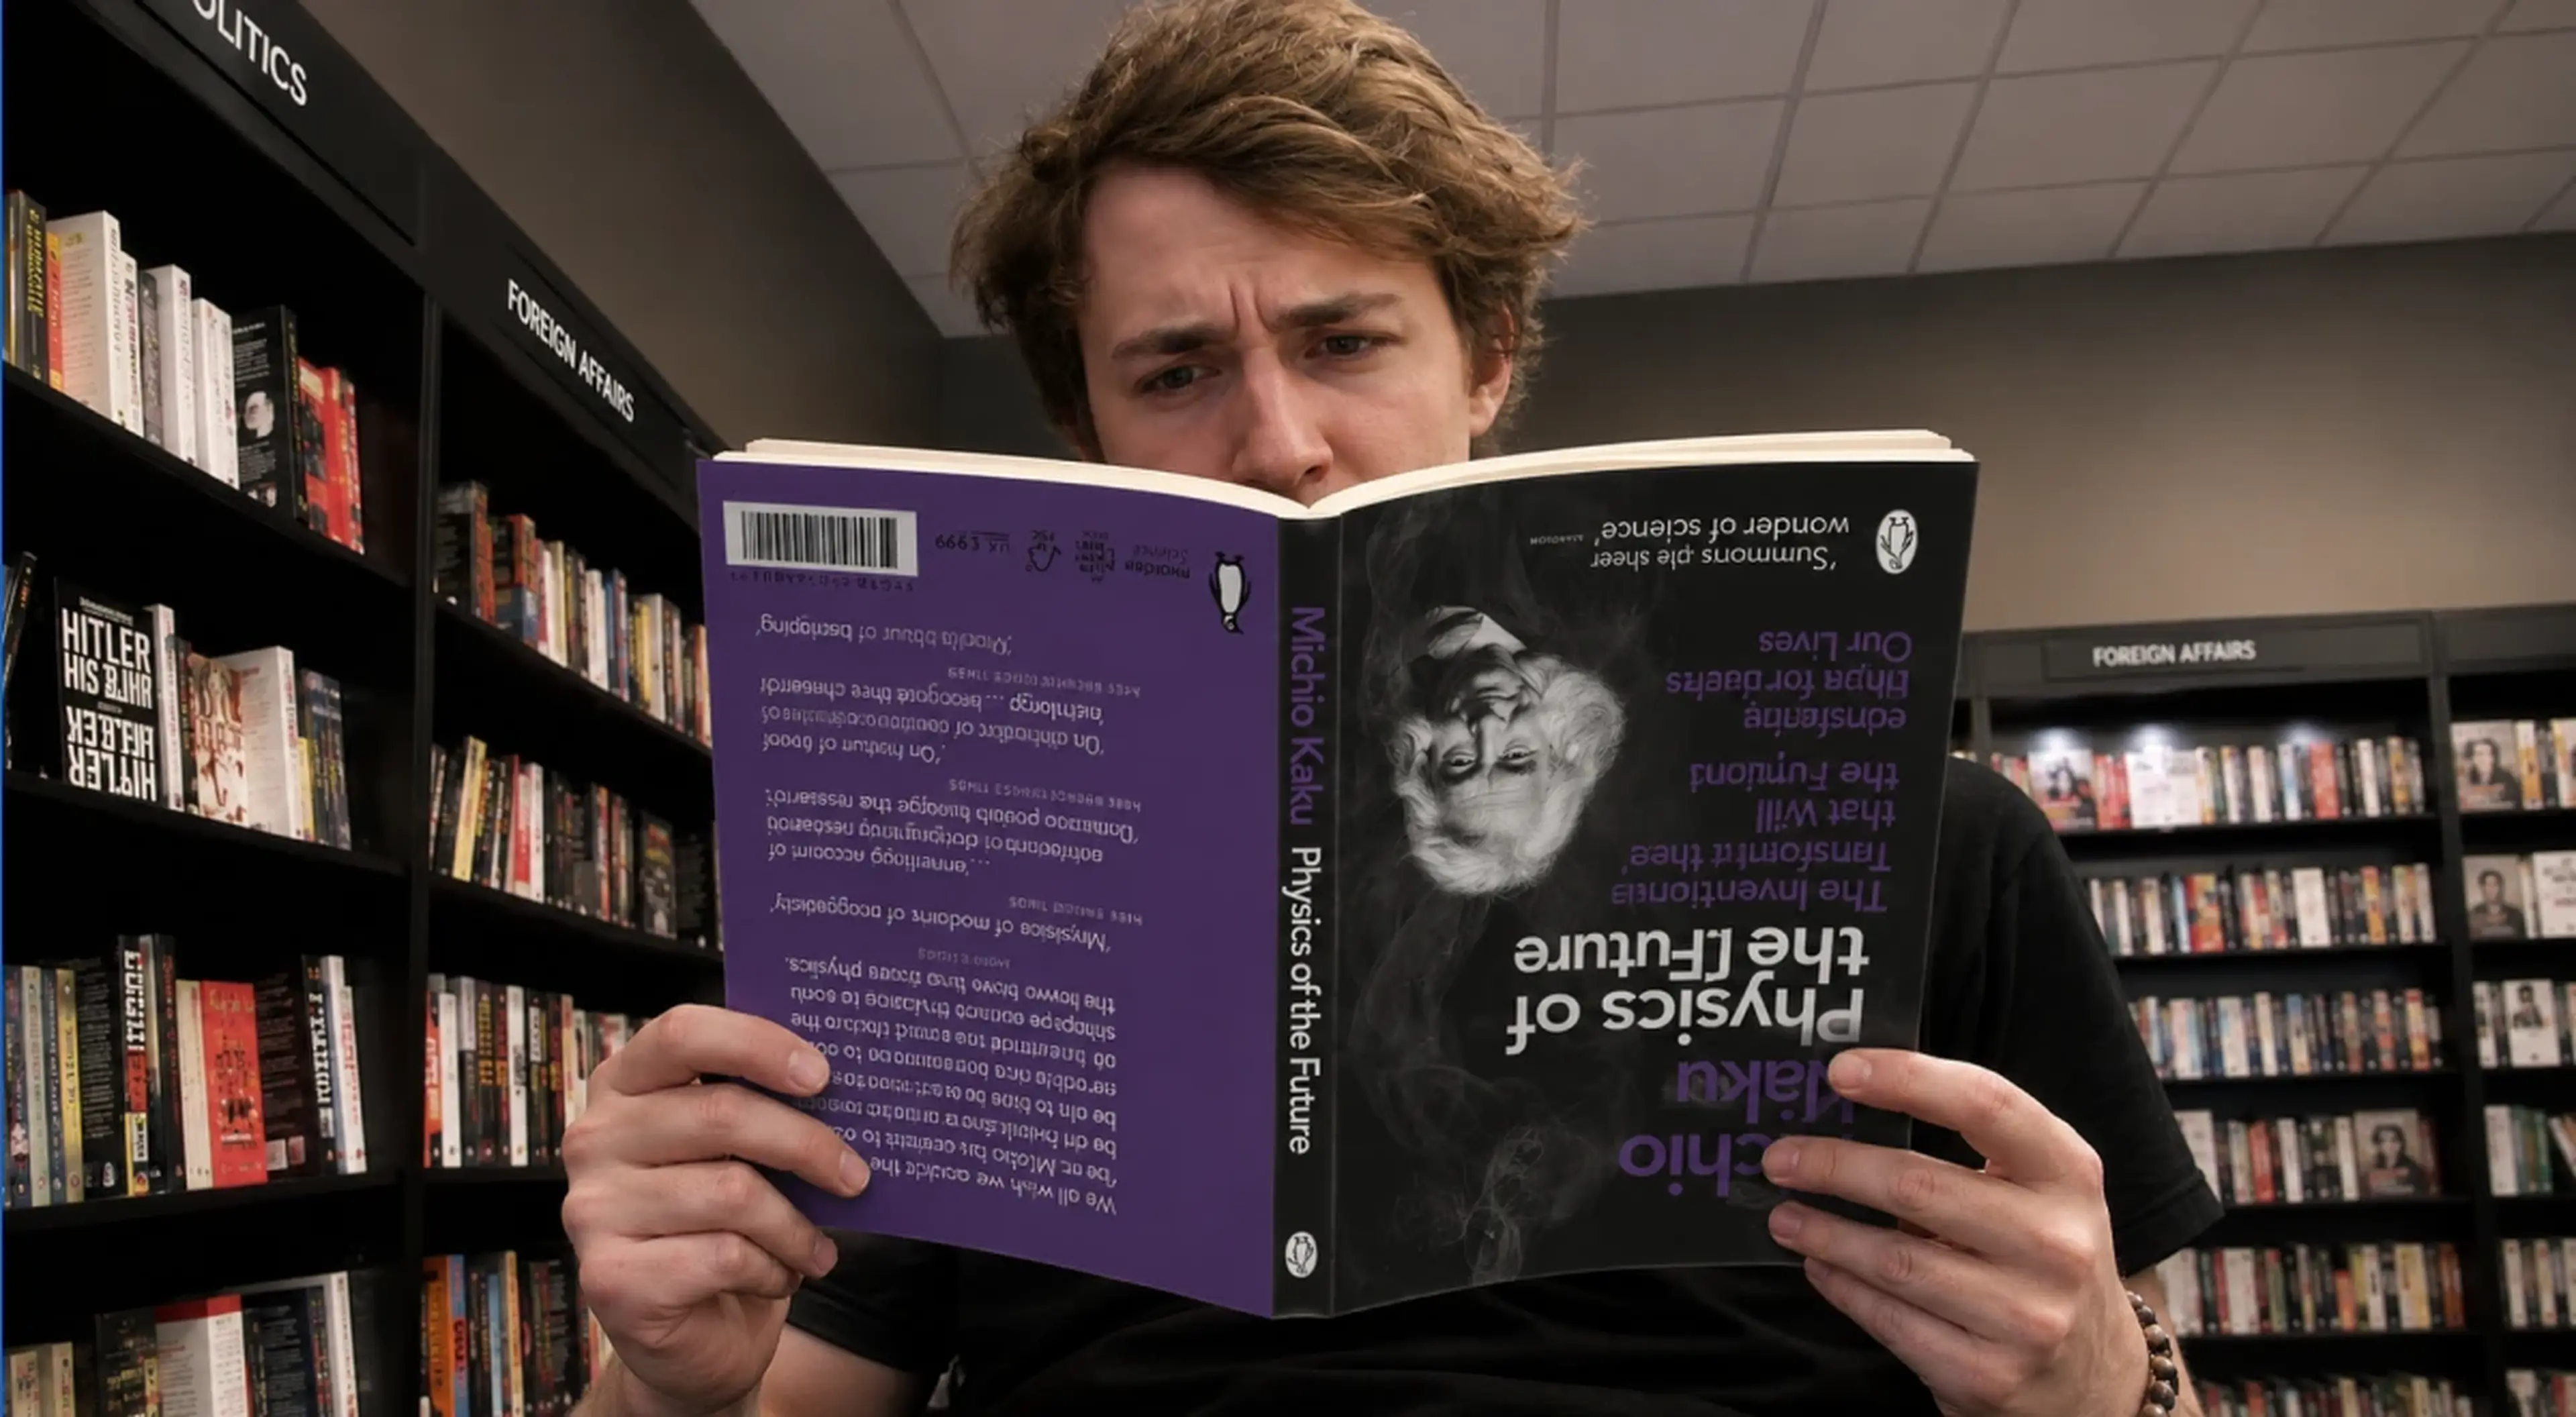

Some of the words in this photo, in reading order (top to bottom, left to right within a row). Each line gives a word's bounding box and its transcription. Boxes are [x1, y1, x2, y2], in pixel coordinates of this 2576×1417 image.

[508, 278, 576, 368] FOREIGN
[578, 348, 634, 423] AFFAIRS
[1707, 516, 1737, 544] of
[1742, 515, 1850, 541] wonder
[1590, 549, 1651, 573] sheer
[62, 607, 151, 674] HITLER
[1758, 629, 1838, 662] Lives
[1845, 630, 1913, 664] Our
[2092, 643, 2176, 668] FOREIGN
[2180, 639, 2257, 664] AFFAIRS
[64, 651, 100, 696] HIS
[1290, 607, 1326, 727] Michio
[1289, 737, 1325, 826] Kaku
[1839, 761, 1900, 794] the
[1754, 798, 1819, 835] Will
[1827, 798, 1896, 832] that
[767, 842, 788, 862] of
[1281, 847, 1322, 957] Physics
[1819, 879, 1888, 914] The
[885, 906, 906, 927] of
[992, 918, 1015, 938] of
[1746, 925, 1871, 986] the
[1289, 963, 1322, 996] of
[1083, 992, 1116, 1016] the
[1600, 969, 1865, 1048] Physics
[1289, 999, 1322, 1051] the
[1504, 992, 1582, 1056] of
[1092, 1108, 1118, 1133] be
[1288, 1057, 1321, 1155] Future
[1092, 1137, 1118, 1161] be
[1617, 1133, 1773, 1198] chio
[975, 1171, 1006, 1190] we
[1085, 1190, 1118, 1216] We
